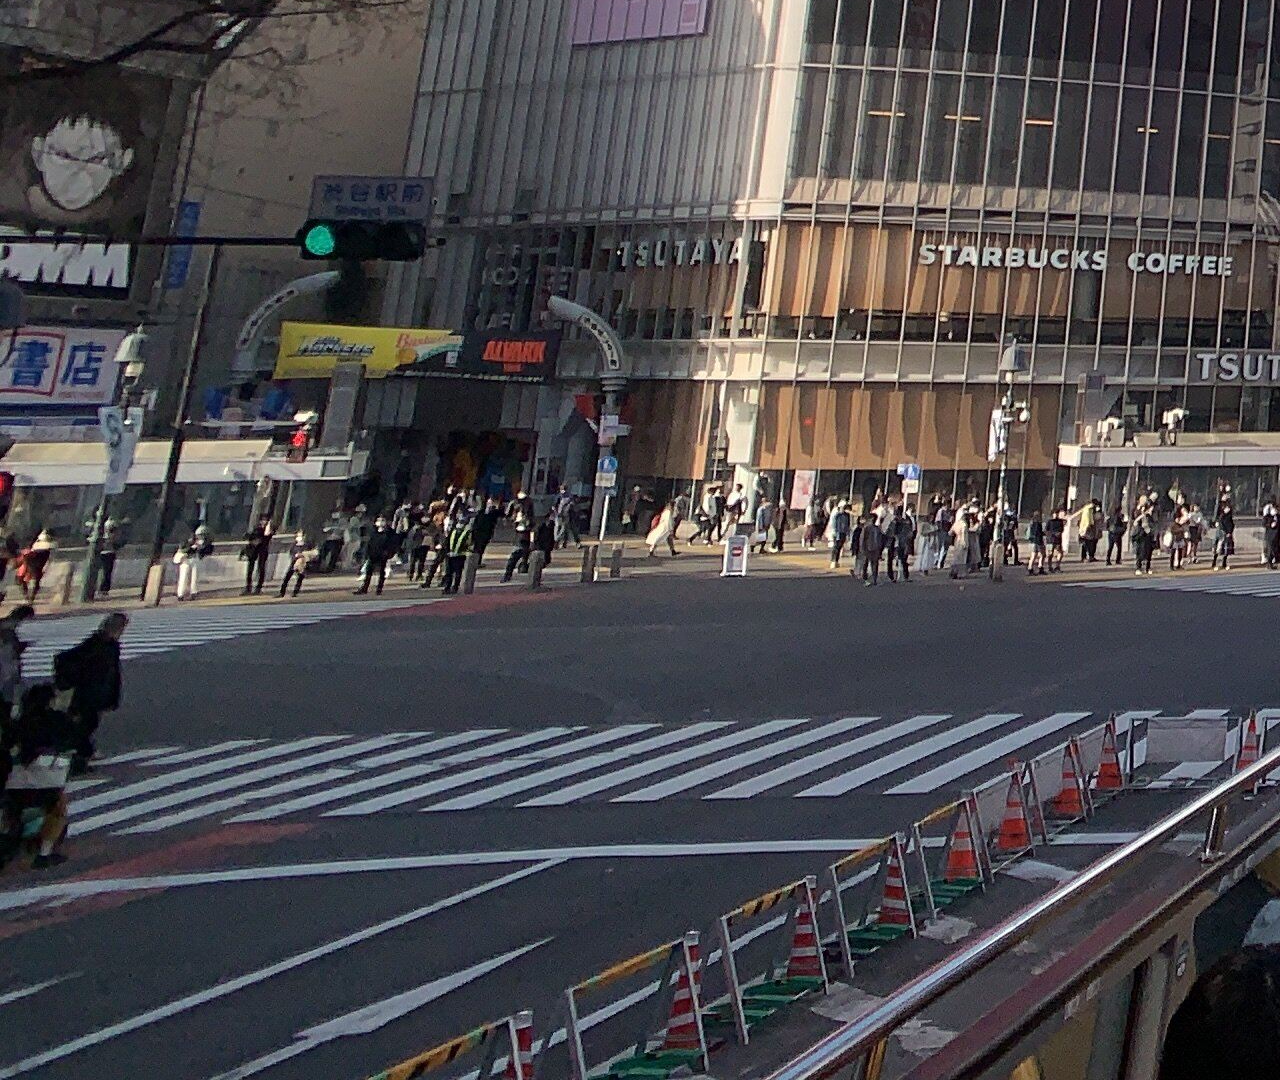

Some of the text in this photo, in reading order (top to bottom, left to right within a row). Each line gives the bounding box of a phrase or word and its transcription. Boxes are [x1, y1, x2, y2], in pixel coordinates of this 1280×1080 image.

[618, 237, 745, 268] TSUTAYA
[917, 244, 1234, 277] STARBUCKS COFFEE
[9, 340, 108, 388] 書店
